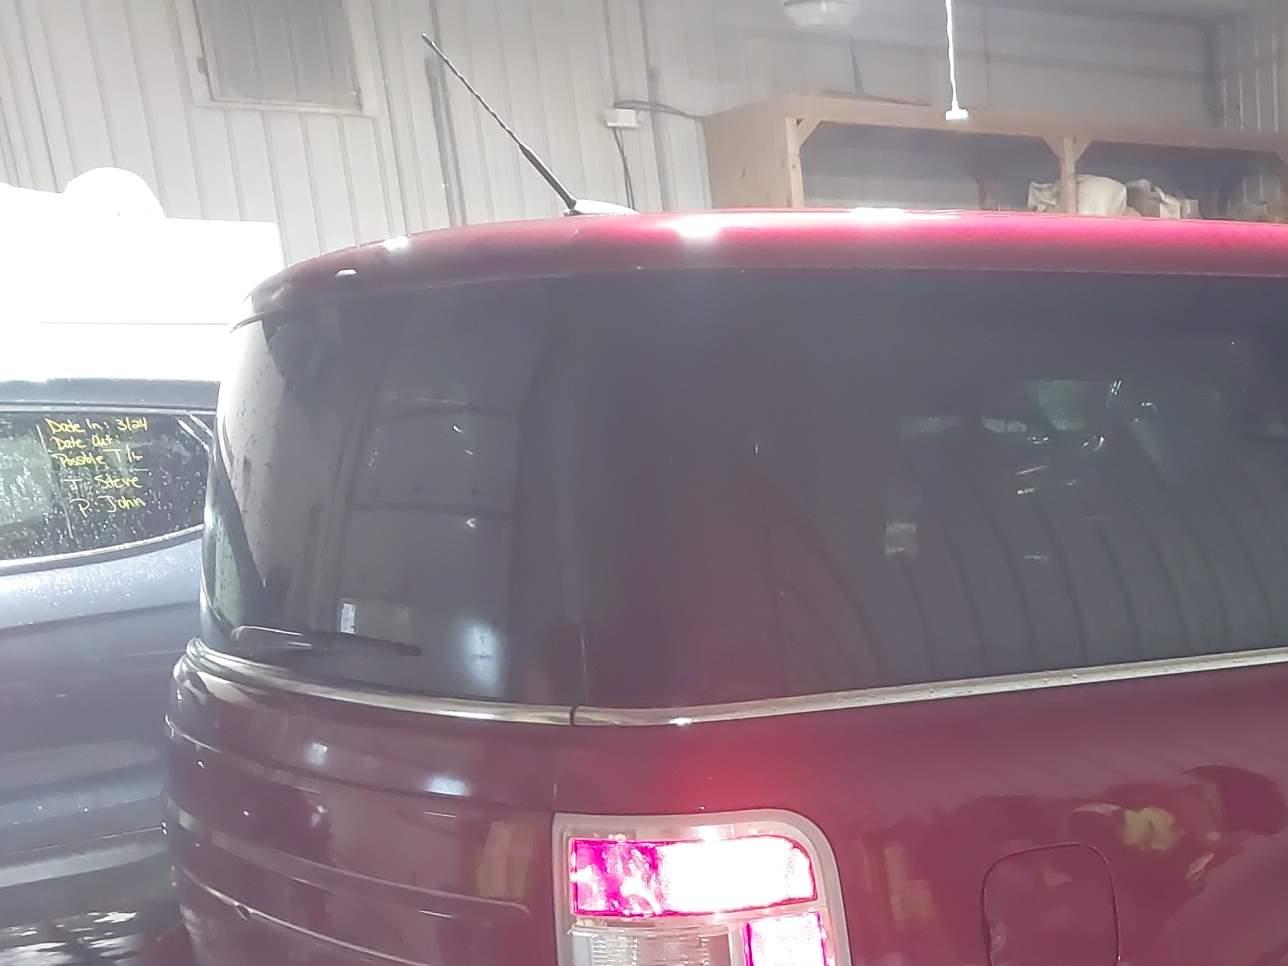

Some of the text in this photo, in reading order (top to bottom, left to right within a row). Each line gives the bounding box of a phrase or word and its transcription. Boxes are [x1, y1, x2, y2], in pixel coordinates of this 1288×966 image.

[46, 418, 86, 434] Date
[52, 436, 87, 450] Date
[94, 473, 144, 490] Steve
[97, 495, 147, 512] John
